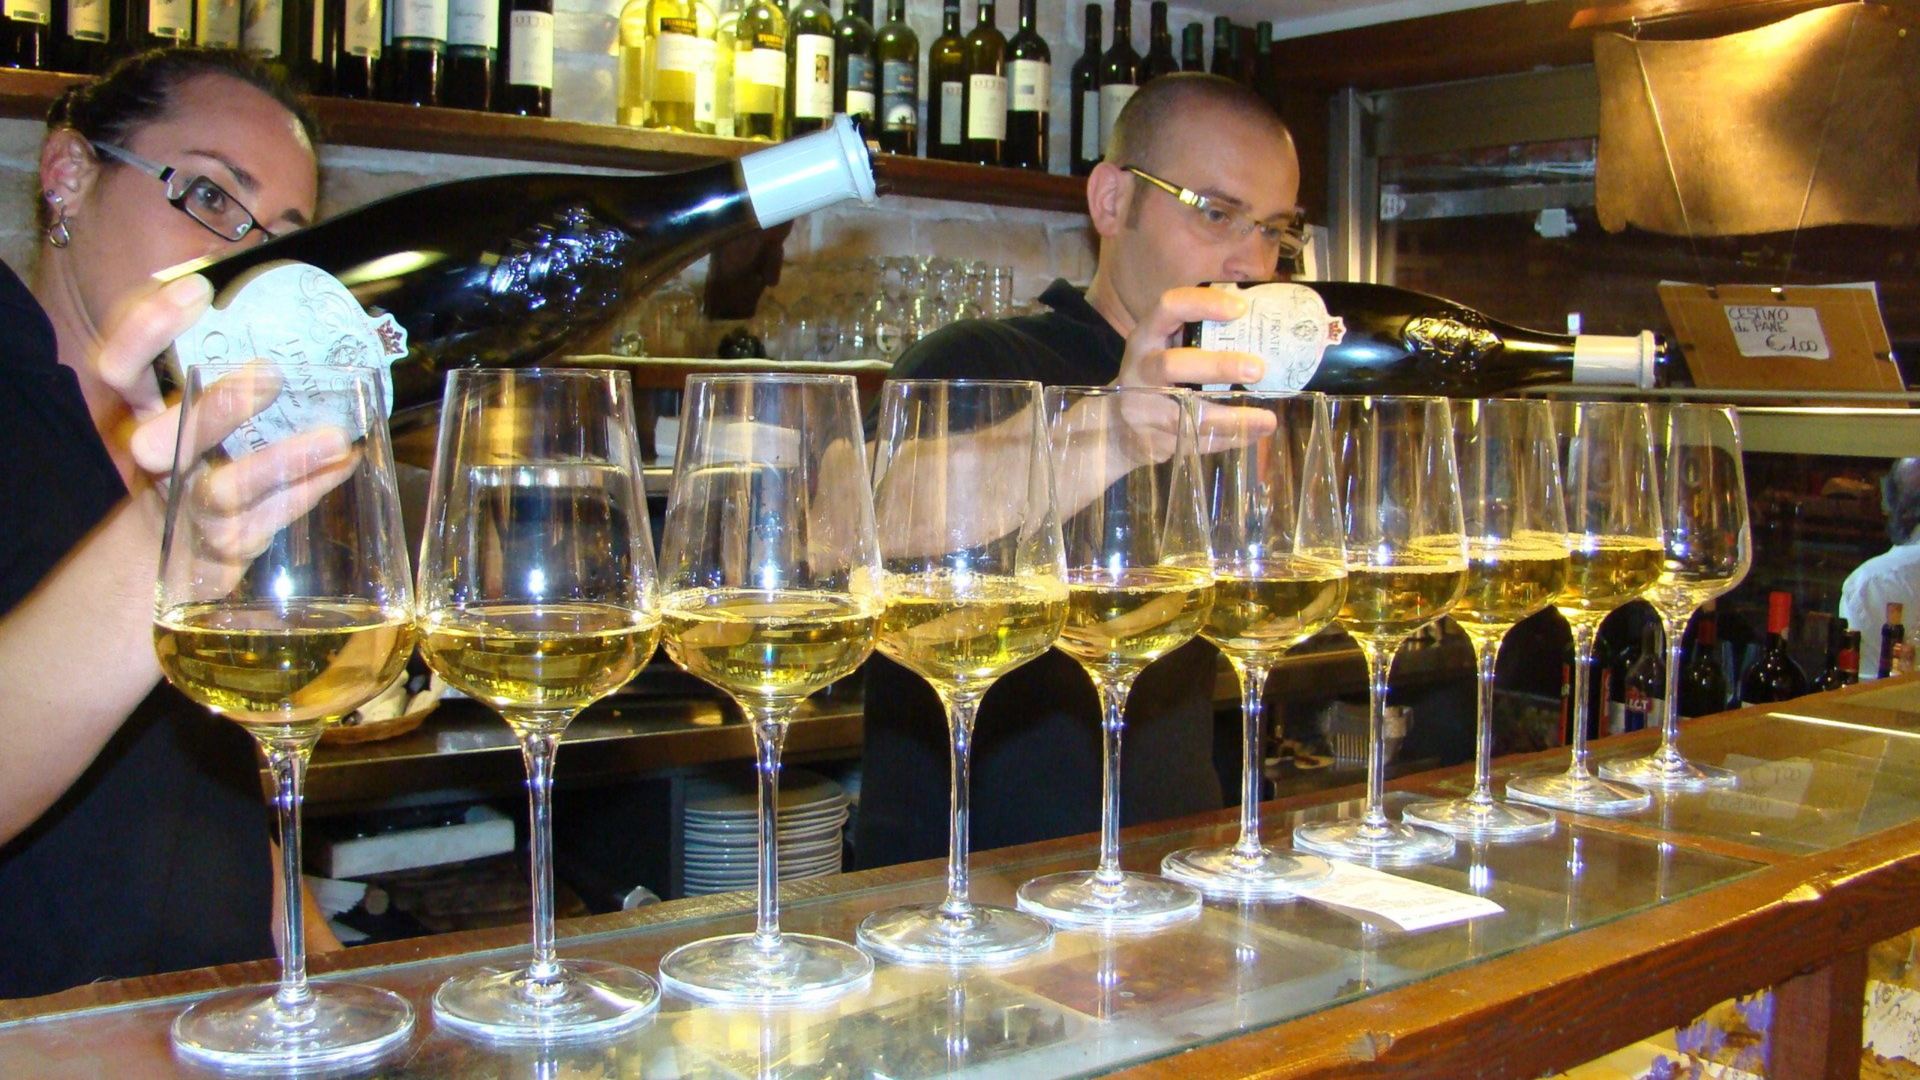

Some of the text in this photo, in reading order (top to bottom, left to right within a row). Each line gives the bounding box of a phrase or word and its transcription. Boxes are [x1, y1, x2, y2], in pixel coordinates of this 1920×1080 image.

[1728, 307, 1789, 321] CESTINO
[1269, 319, 1281, 351] FRATI
[1753, 320, 1787, 333] PANE
[290, 350, 322, 399] FRATI
